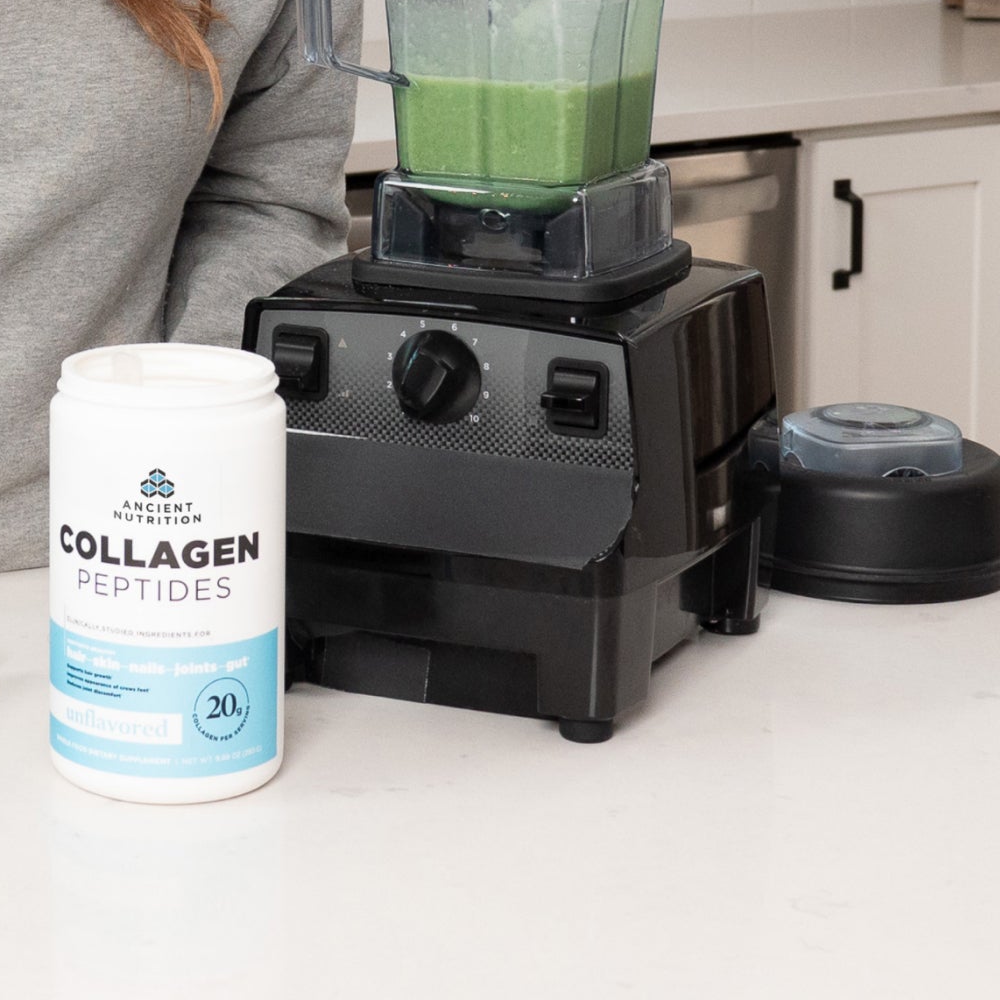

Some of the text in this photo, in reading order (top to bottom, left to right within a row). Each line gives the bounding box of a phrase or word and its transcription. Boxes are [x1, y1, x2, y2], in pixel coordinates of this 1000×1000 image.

[419, 320, 426, 328] 5
[451, 323, 458, 331] 6
[400, 330, 407, 338] 4
[472, 338, 478, 346] 7
[387, 352, 393, 360] 3
[483, 363, 490, 371] 8
[386, 381, 393, 389] 2
[469, 415, 480, 423] 10
[122, 500, 193, 513] ANCIENT
[113, 510, 202, 525] NUTRITION
[60, 524, 259, 569] COLLAGEN
[77, 568, 231, 602] PEPTIDES
[136, 630, 191, 639] INGREDIENTS
[194, 629, 211, 638] FOR
[92, 655, 121, 672] skin
[128, 661, 165, 675] nails
[173, 661, 217, 678] joints
[206, 692, 242, 720] 20g
[65, 707, 168, 738] unflavored
[192, 713, 218, 741] COLLAGEN
[220, 733, 233, 742] PER
